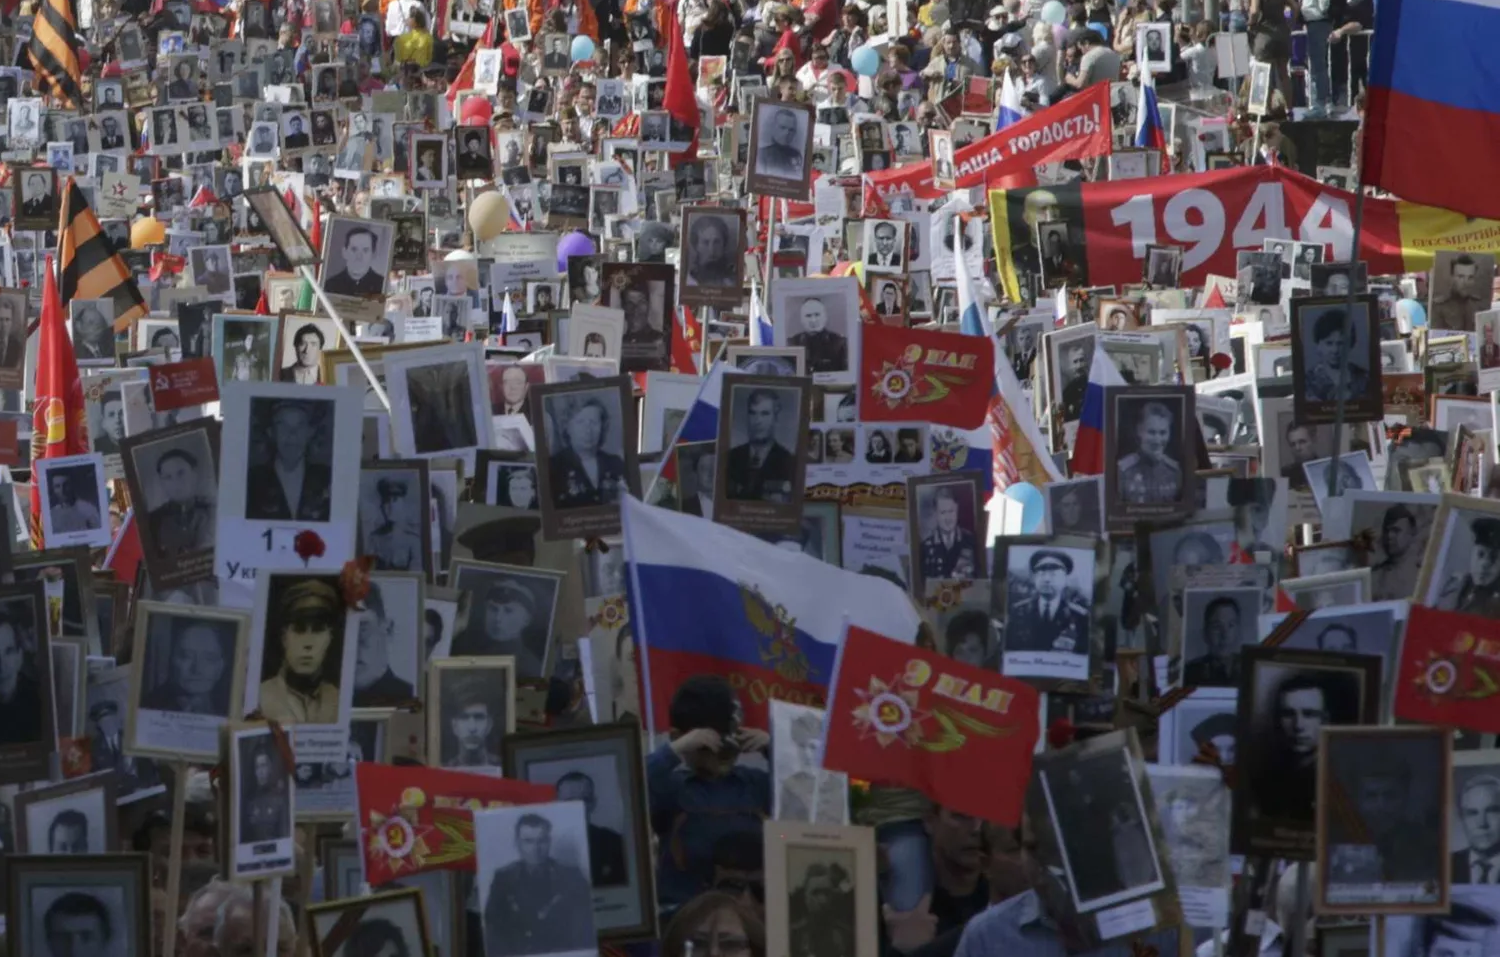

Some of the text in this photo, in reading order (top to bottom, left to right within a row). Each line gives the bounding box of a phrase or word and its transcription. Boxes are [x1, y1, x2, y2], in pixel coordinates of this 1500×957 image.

[1008, 103, 1101, 155] ГОРДОСТЬ!
[1111, 181, 1355, 272] 1944
[923, 349, 978, 370] МАЯ
[903, 659, 1016, 714] 9 МАЯ
